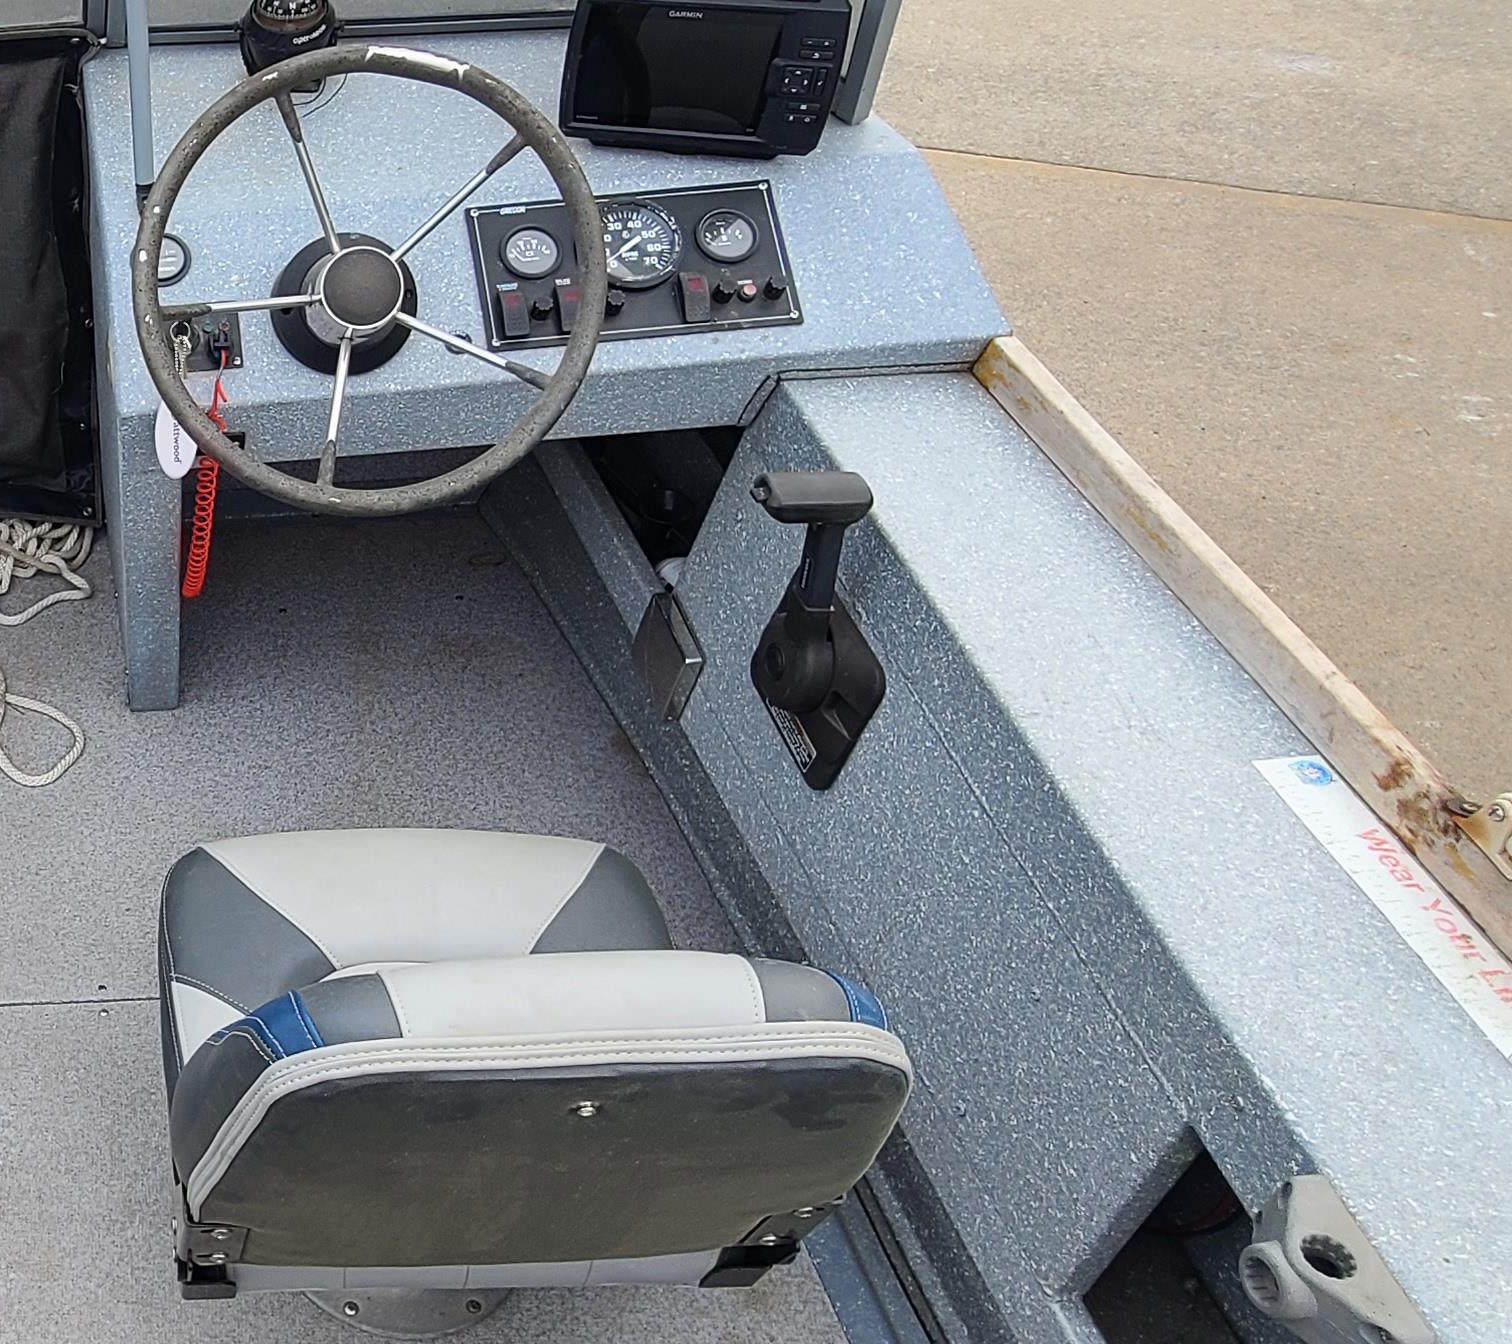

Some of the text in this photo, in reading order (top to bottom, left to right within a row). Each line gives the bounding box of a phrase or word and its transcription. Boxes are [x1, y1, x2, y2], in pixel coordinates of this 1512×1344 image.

[668, 10, 704, 19] GARMIN
[607, 222, 622, 231] 30
[627, 220, 642, 229] 40
[641, 230, 656, 239] 50
[647, 243, 662, 252] 60
[643, 256, 658, 265] 70
[1356, 827, 1426, 894] Wear
[1421, 898, 1487, 963] Your
